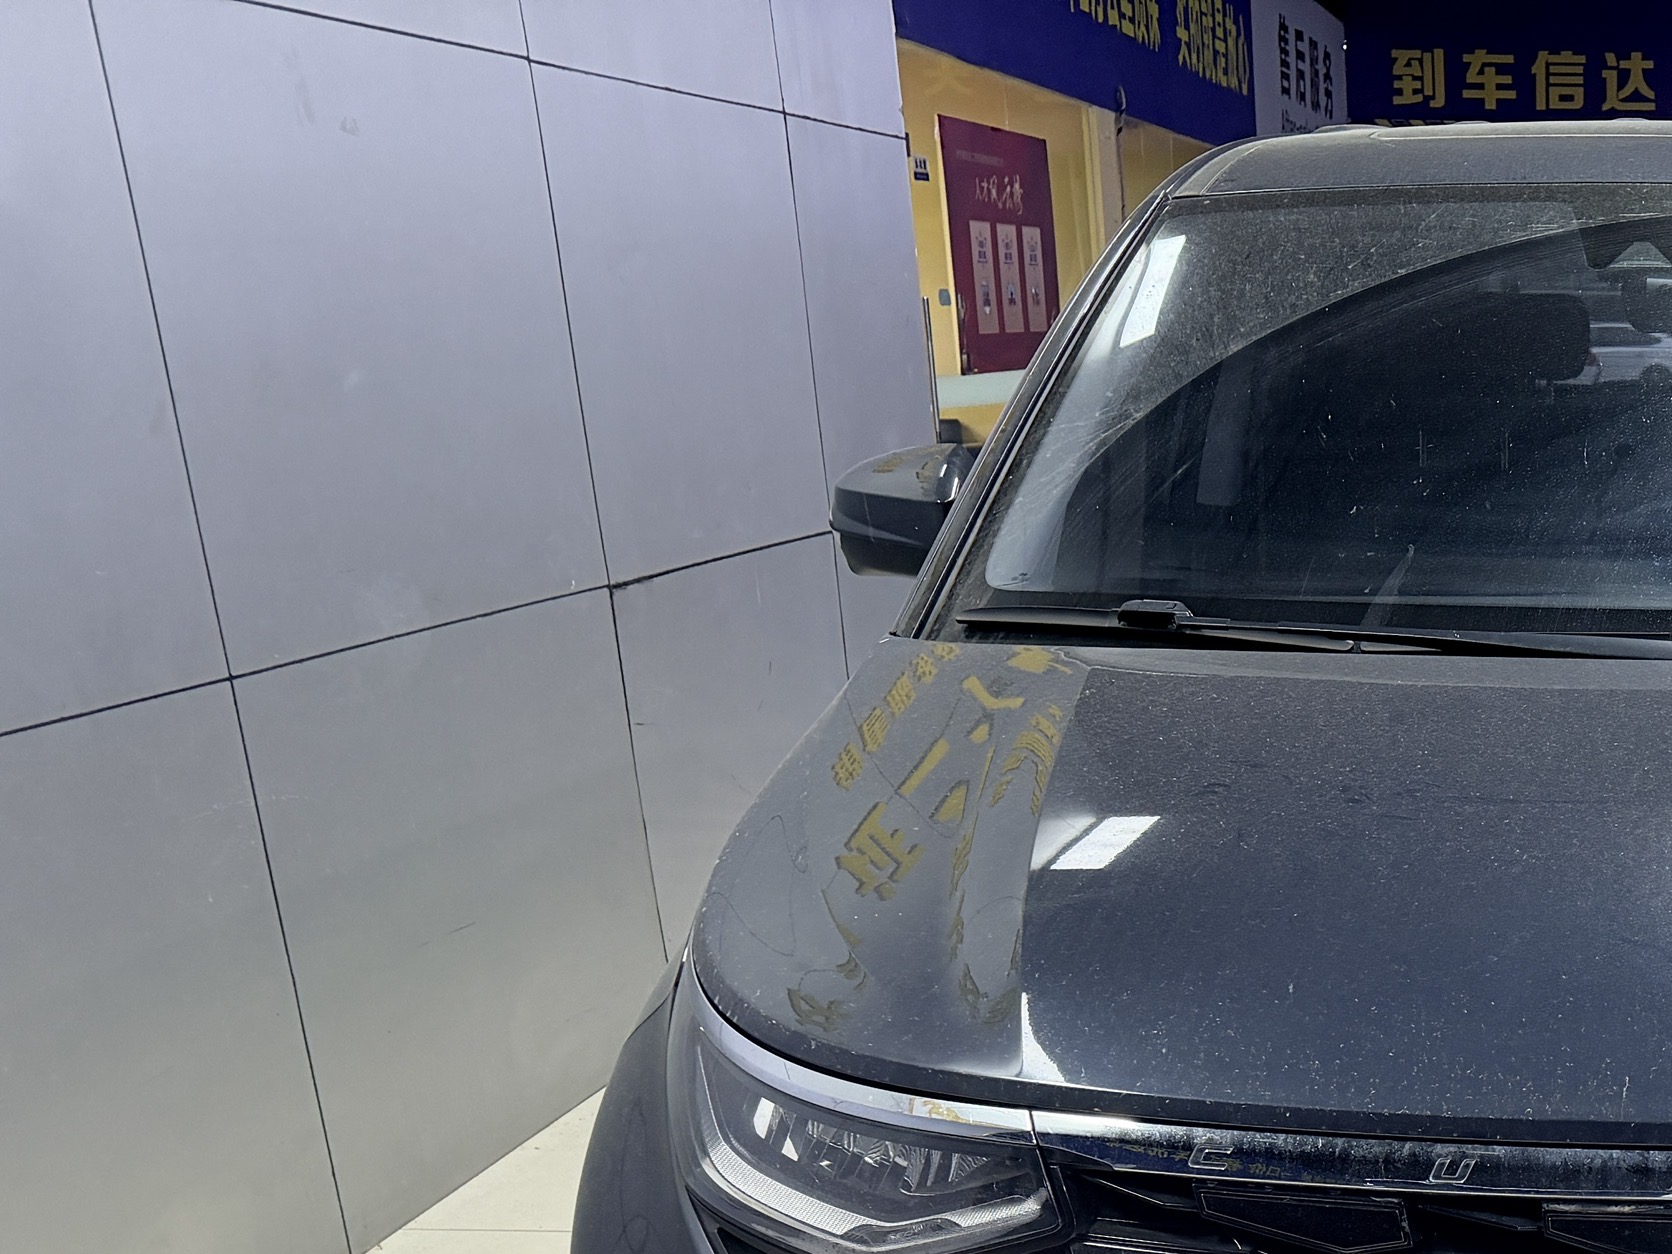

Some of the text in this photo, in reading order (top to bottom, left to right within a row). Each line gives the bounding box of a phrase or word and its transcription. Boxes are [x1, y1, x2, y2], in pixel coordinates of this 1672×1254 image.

[1278, 13, 1333, 120] 售后服务
[1391, 48, 1655, 111] 到车信达
